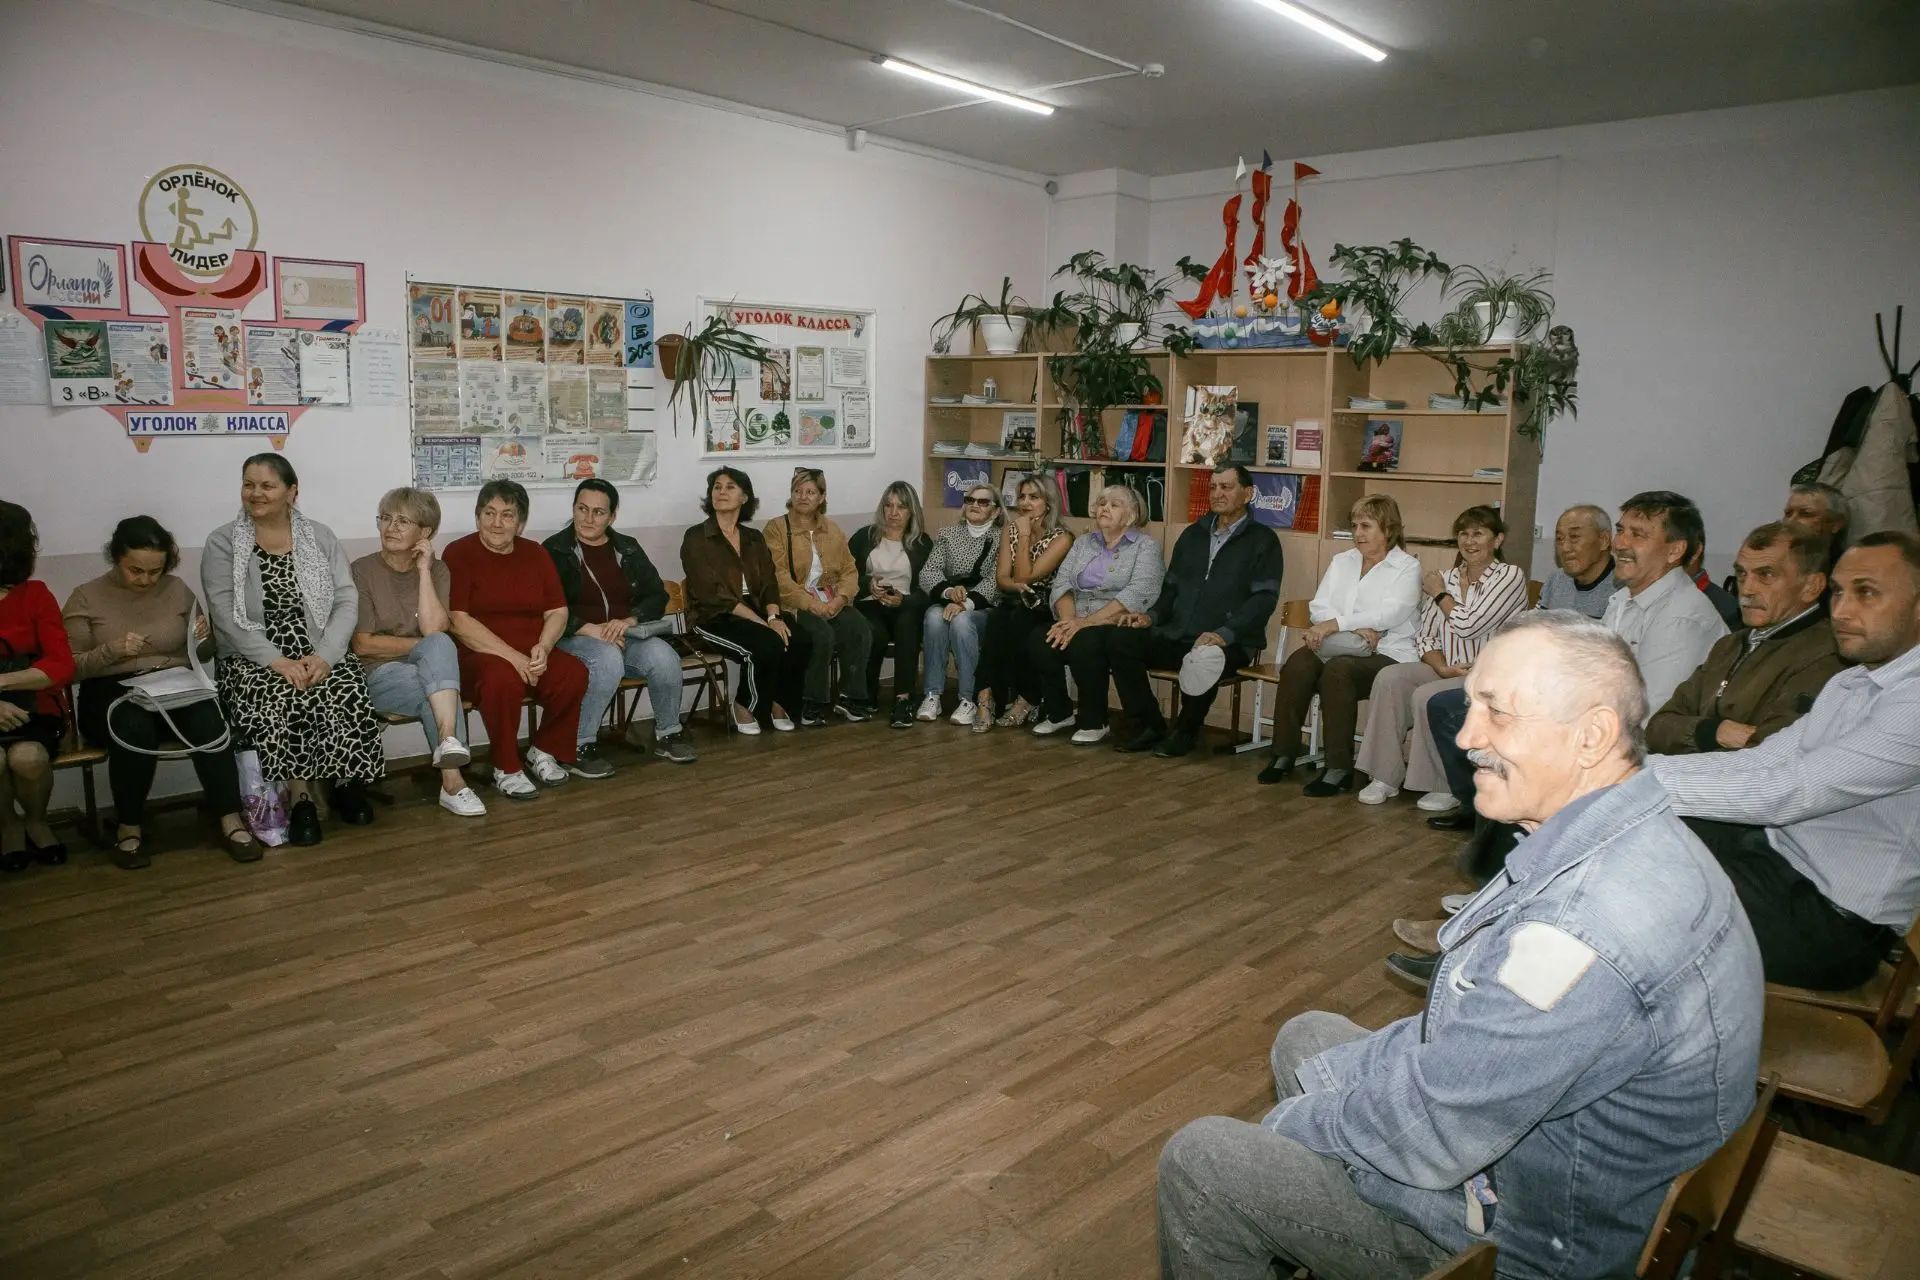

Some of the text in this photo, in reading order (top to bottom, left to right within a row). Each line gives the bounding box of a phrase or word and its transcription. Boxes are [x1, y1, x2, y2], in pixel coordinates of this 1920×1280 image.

[158, 171, 240, 203] ОРЛЁНОК
[169, 248, 229, 270] ЛИДЕР
[28, 254, 100, 295] Орлята
[735, 312, 851, 330] УГОЛОК КЛАССА
[62, 386, 73, 401] 3
[129, 416, 286, 431] УГОЛОК КЛАССА
